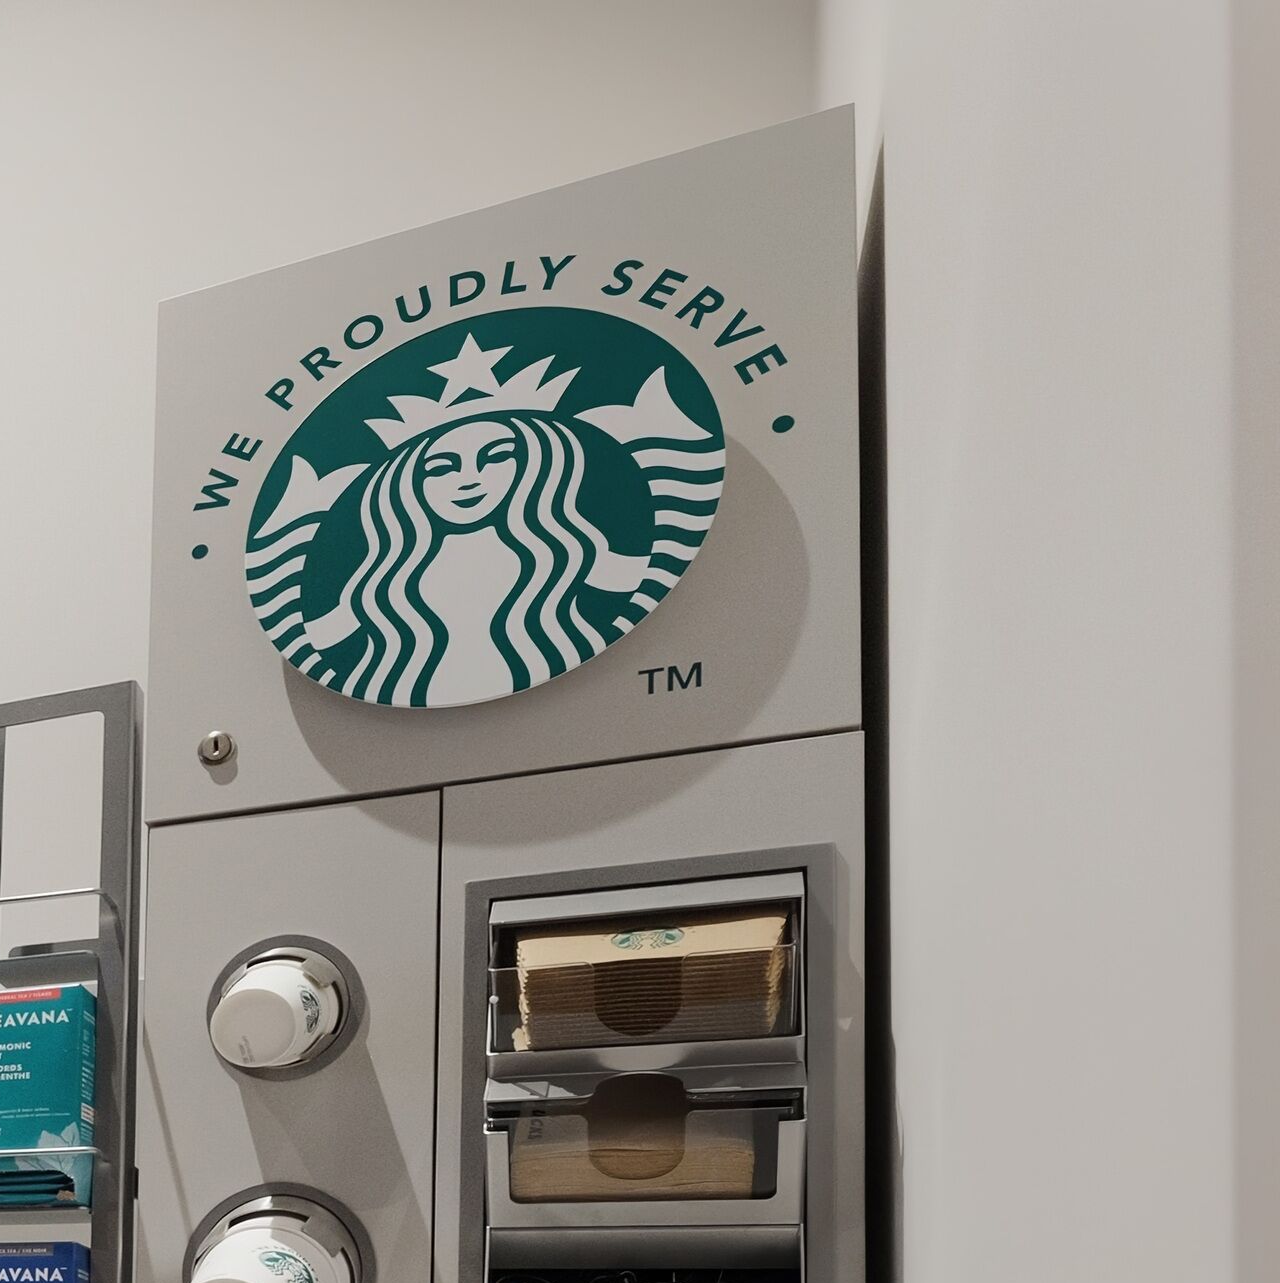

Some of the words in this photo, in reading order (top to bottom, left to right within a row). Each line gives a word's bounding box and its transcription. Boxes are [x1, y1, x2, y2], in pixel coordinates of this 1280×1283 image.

[193, 432, 263, 512] WE
[265, 254, 577, 411] PROUDLY
[600, 258, 788, 386] SERVE
[638, 660, 703, 696] TM
